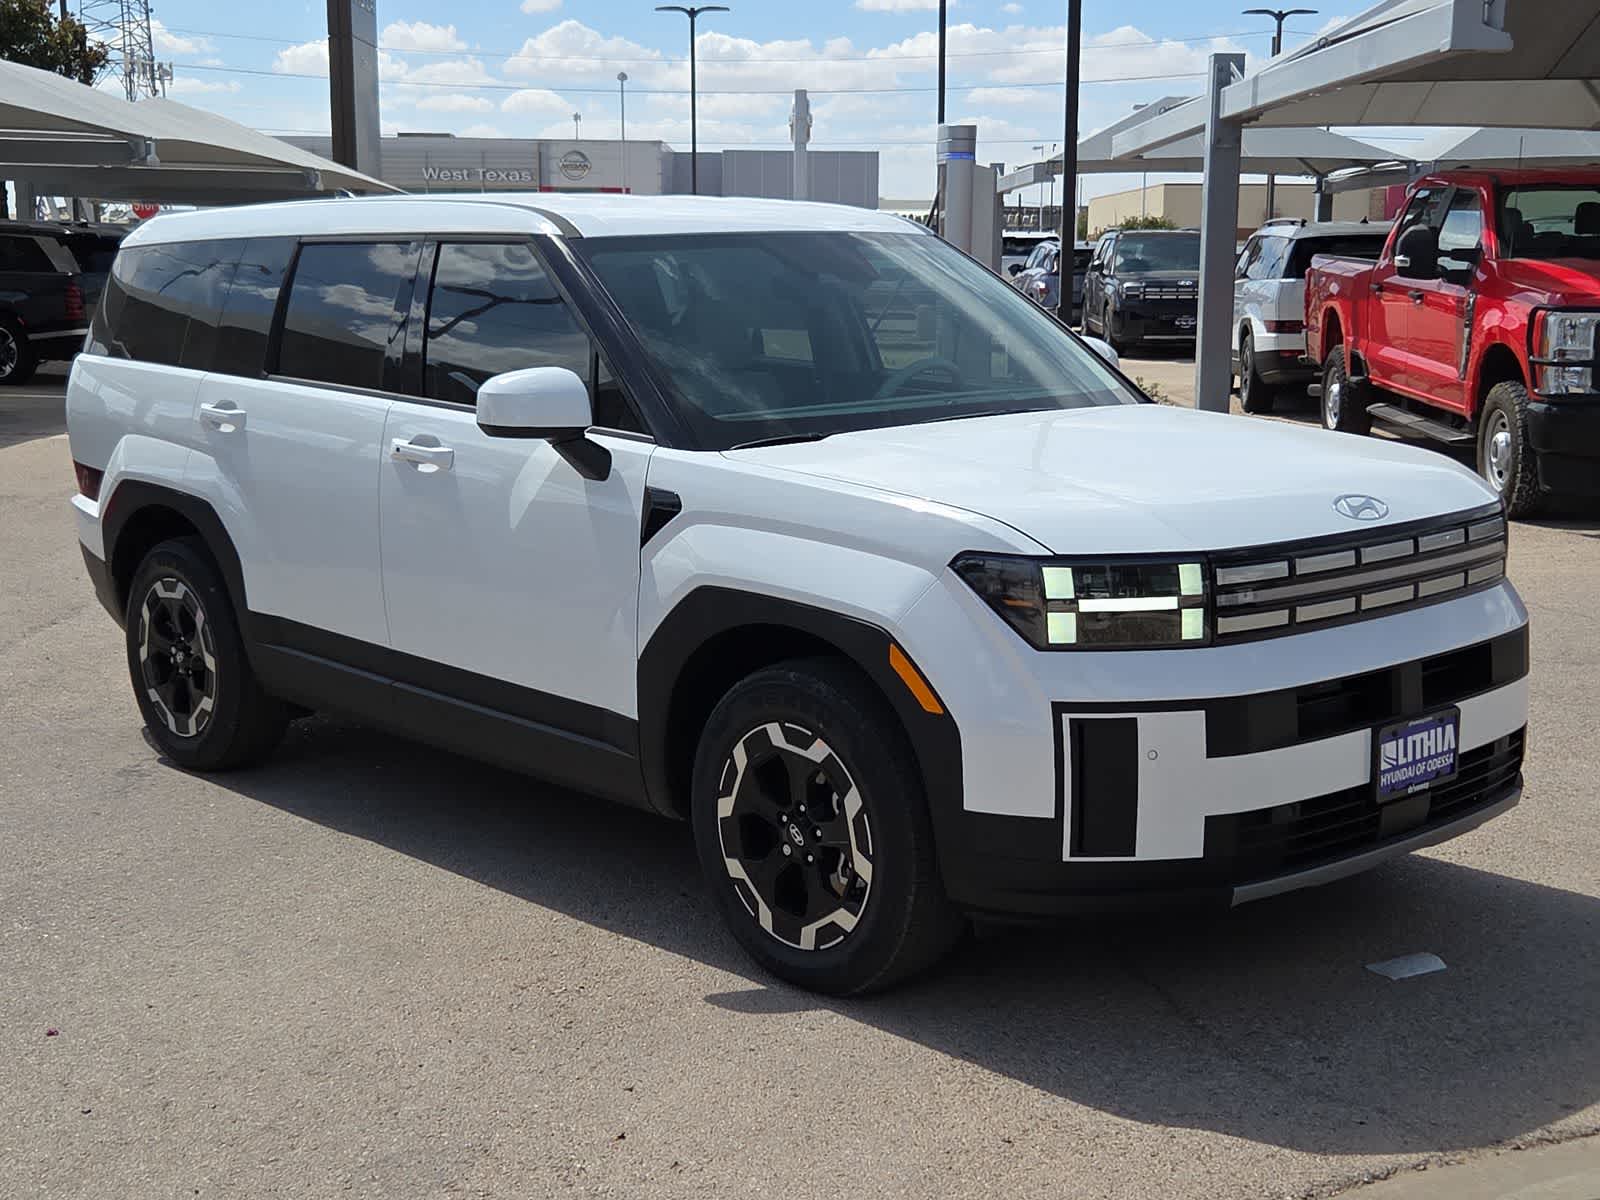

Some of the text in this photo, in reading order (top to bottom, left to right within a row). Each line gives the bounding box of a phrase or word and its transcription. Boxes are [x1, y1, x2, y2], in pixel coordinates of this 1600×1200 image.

[422, 167, 532, 181] West Texas
[1398, 724, 1456, 766] LITHIA
[1381, 766, 1415, 788] HYUNDAI
[1416, 761, 1426, 776] OF
[1427, 753, 1455, 772] ODESSA
